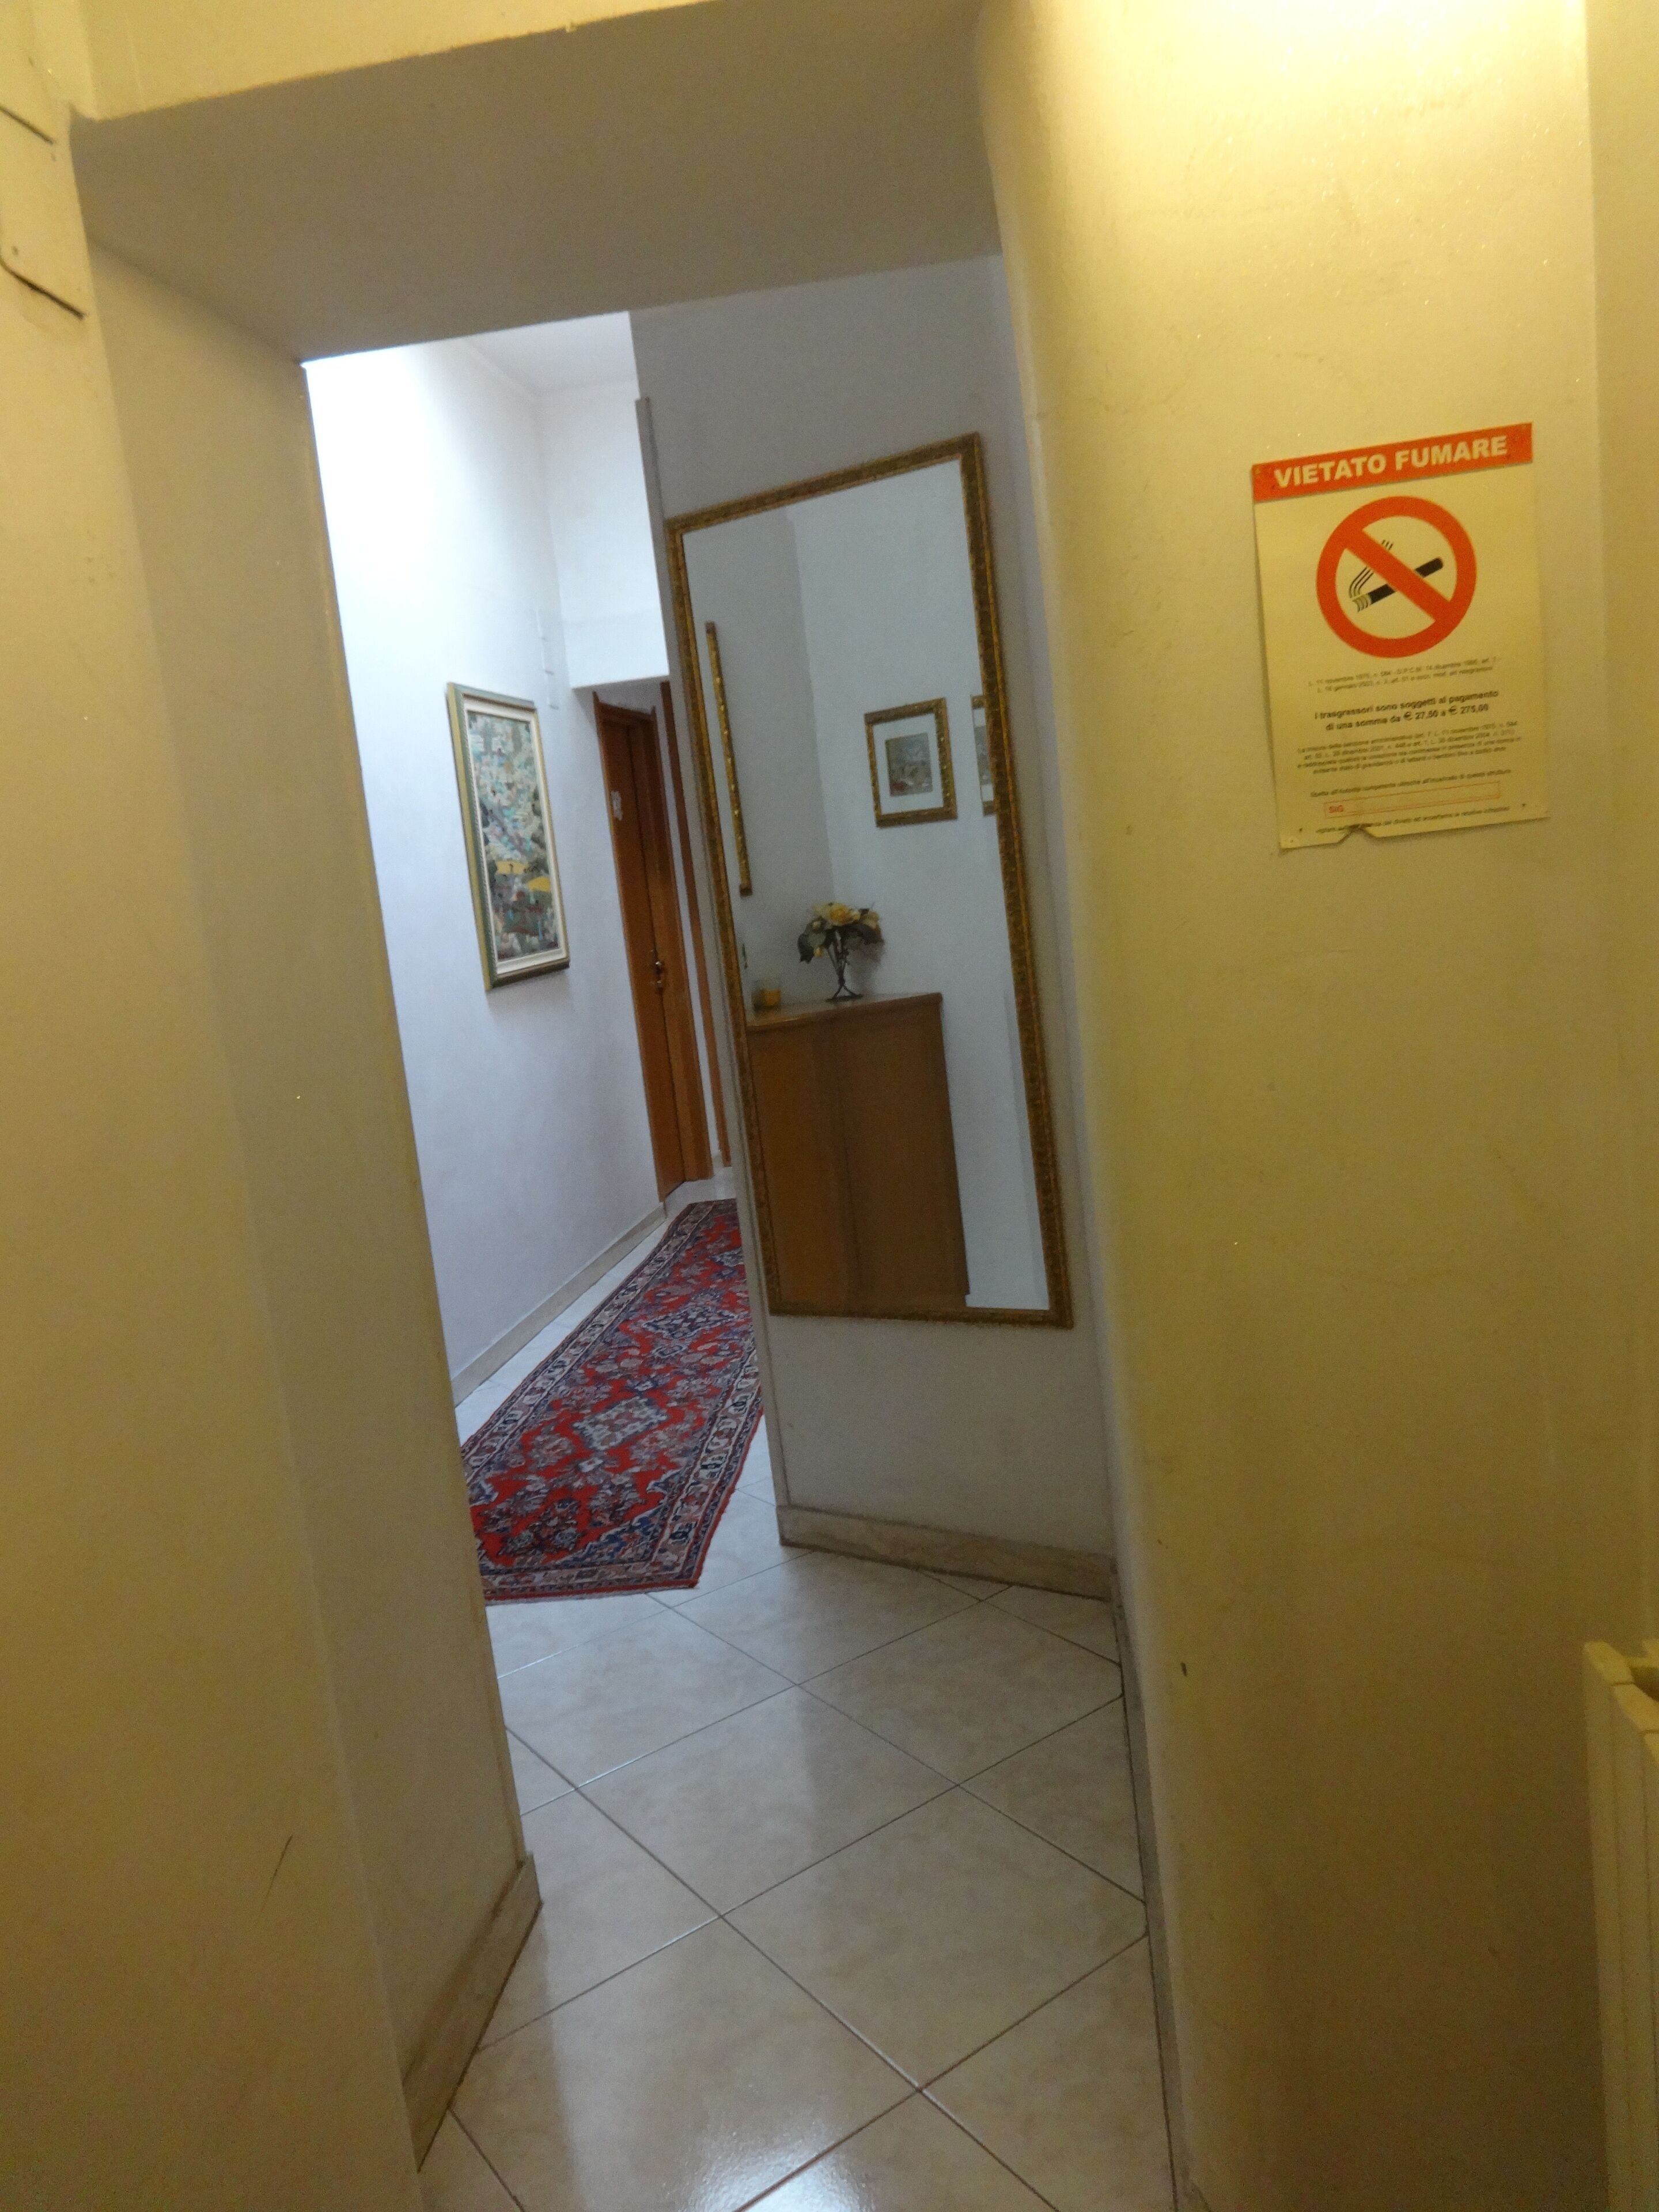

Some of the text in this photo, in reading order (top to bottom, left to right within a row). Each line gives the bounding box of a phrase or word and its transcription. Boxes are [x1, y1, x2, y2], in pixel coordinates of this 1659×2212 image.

[1274, 435, 1508, 488] VIETATO FUMARE
[1320, 705, 1373, 719] trasgressori
[1376, 704, 1397, 712] sono
[1400, 698, 1436, 709] soggetti
[1449, 691, 1498, 704] pagamento
[1355, 718, 1388, 727] somma
[1403, 711, 1412, 720] €
[1448, 706, 1457, 715] €
